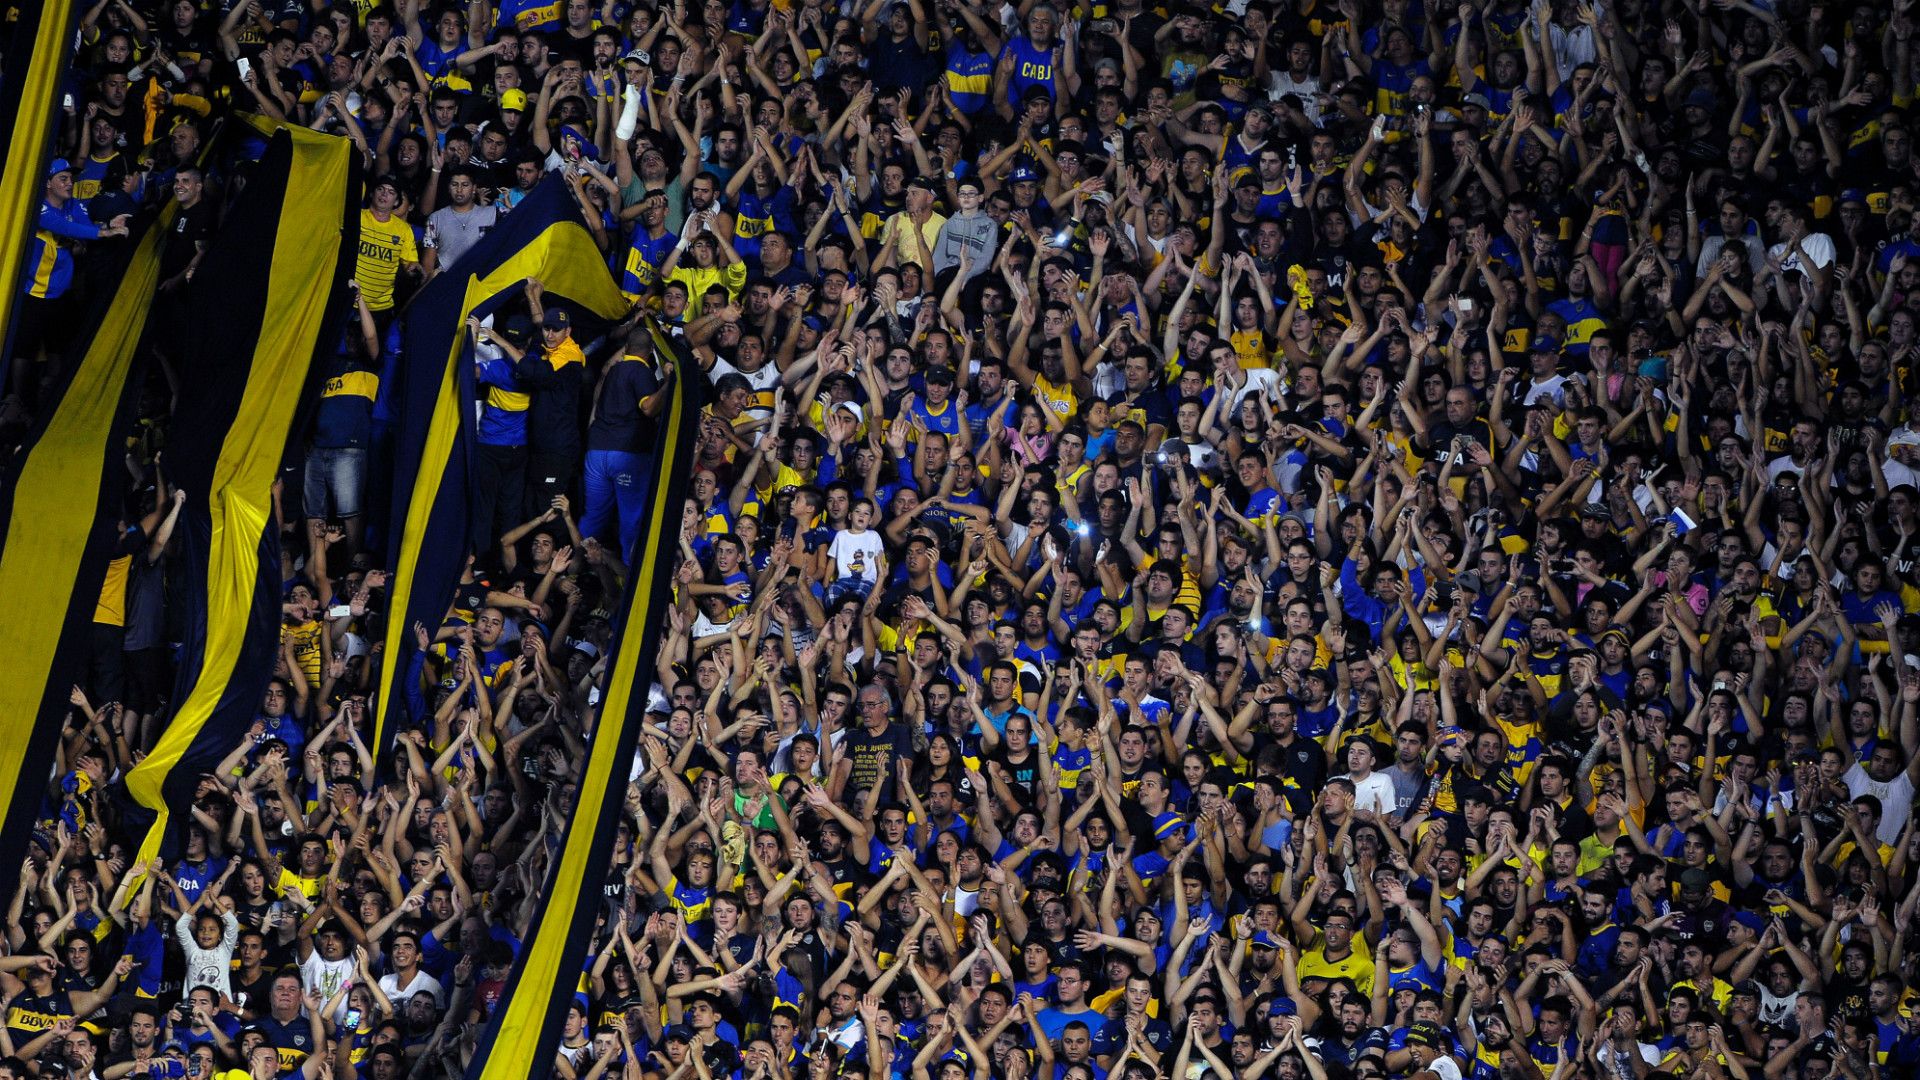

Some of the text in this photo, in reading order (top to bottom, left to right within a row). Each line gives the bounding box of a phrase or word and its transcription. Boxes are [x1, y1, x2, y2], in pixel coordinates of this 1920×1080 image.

[1022, 62, 1051, 80] CABJ
[1016, 168, 1027, 177] 12
[360, 242, 393, 262] BBVA
[20, 1014, 54, 1030] BBVA
